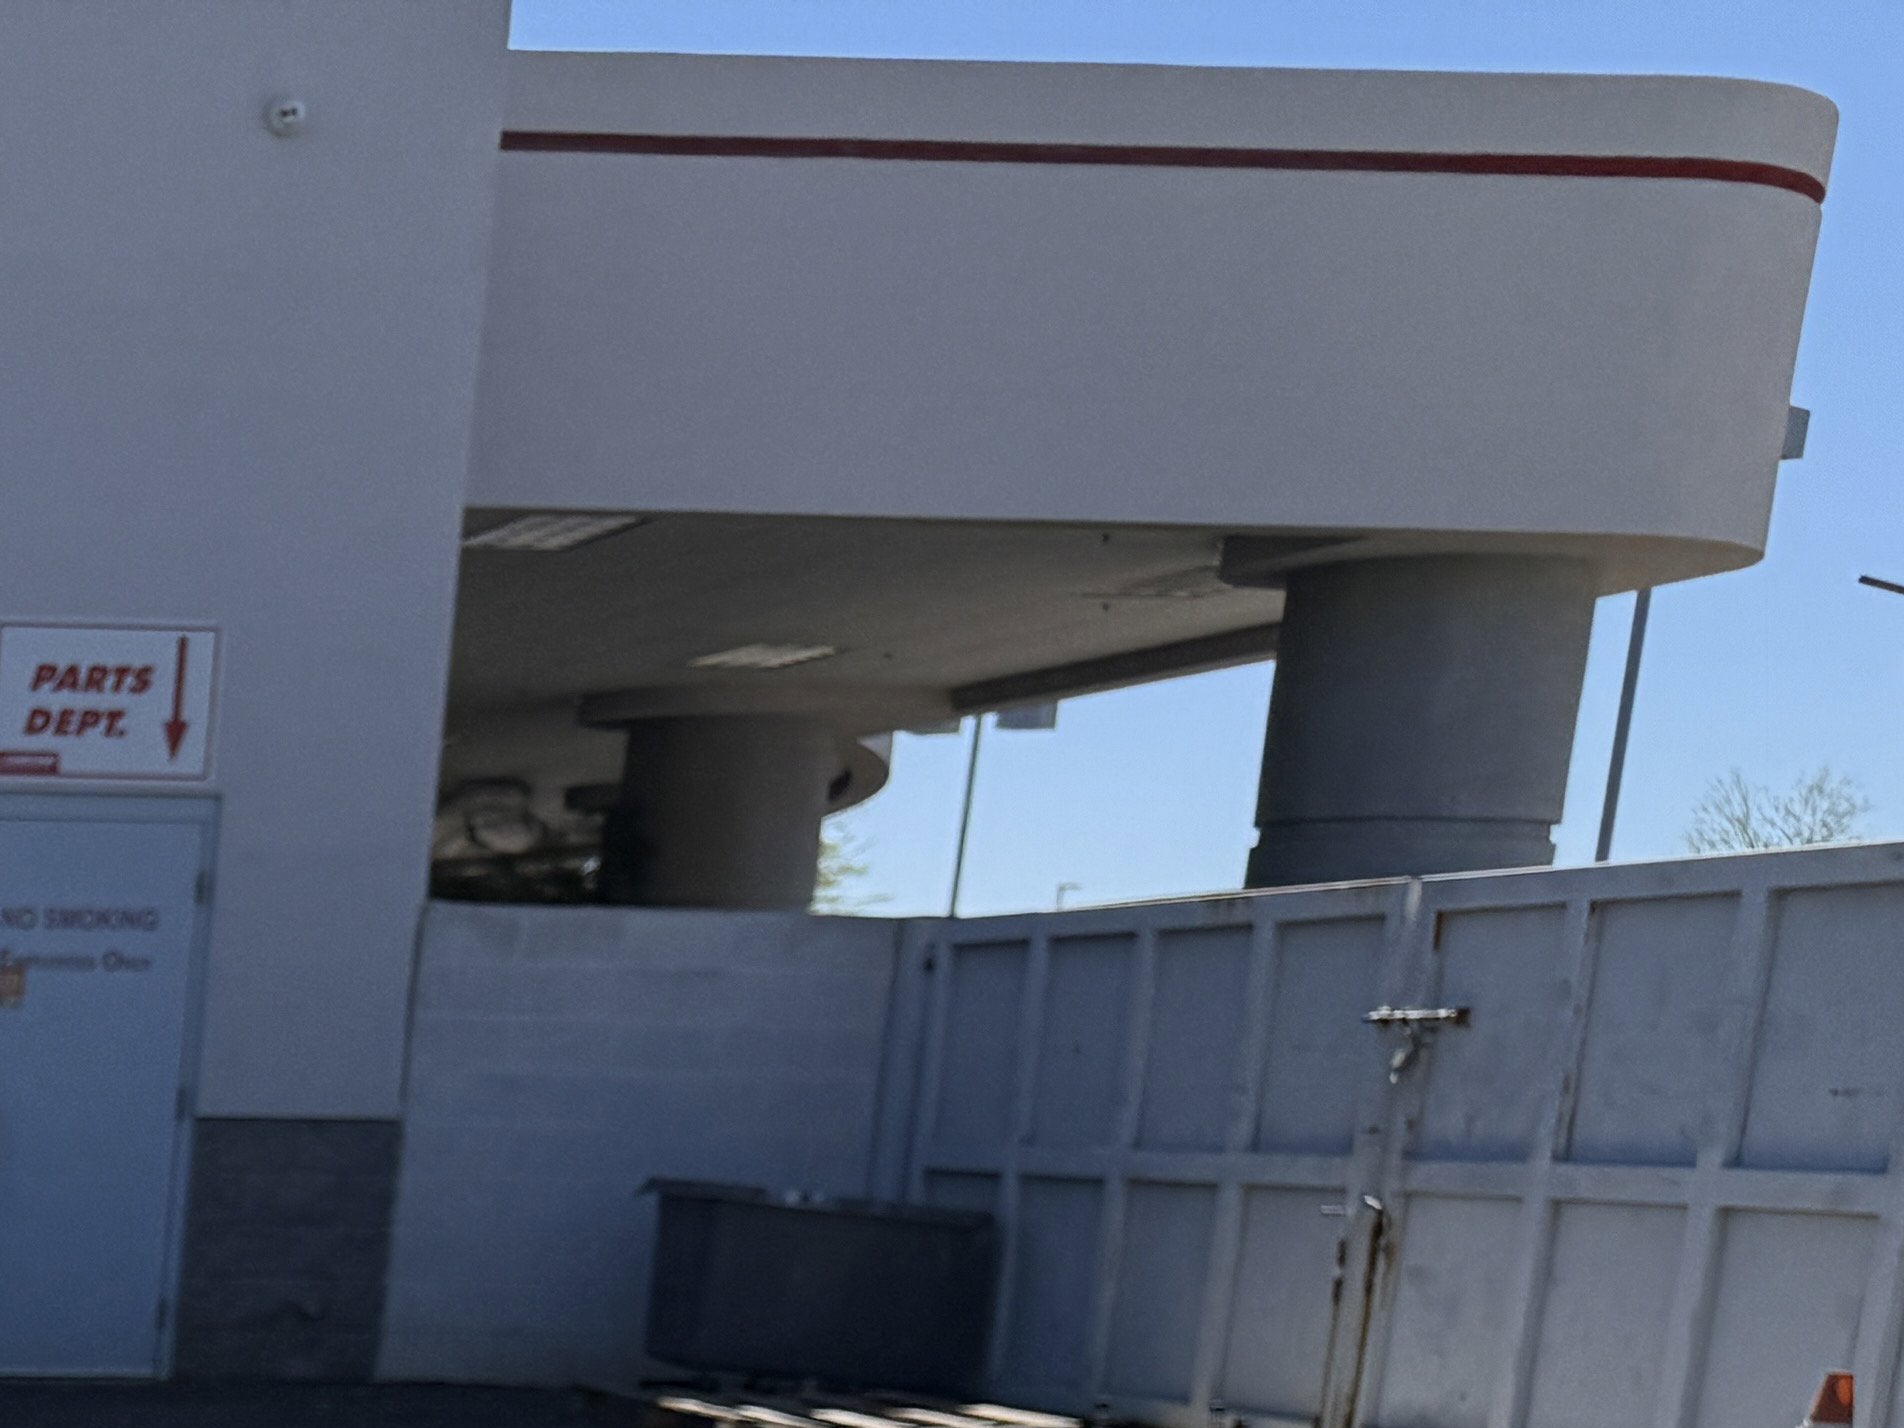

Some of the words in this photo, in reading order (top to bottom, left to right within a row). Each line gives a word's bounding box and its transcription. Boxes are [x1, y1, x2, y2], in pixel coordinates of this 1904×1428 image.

[30, 664, 154, 694] PARTS
[23, 708, 127, 737] DEPT.
[0, 907, 37, 931] NO
[43, 907, 160, 931] SMOKING
